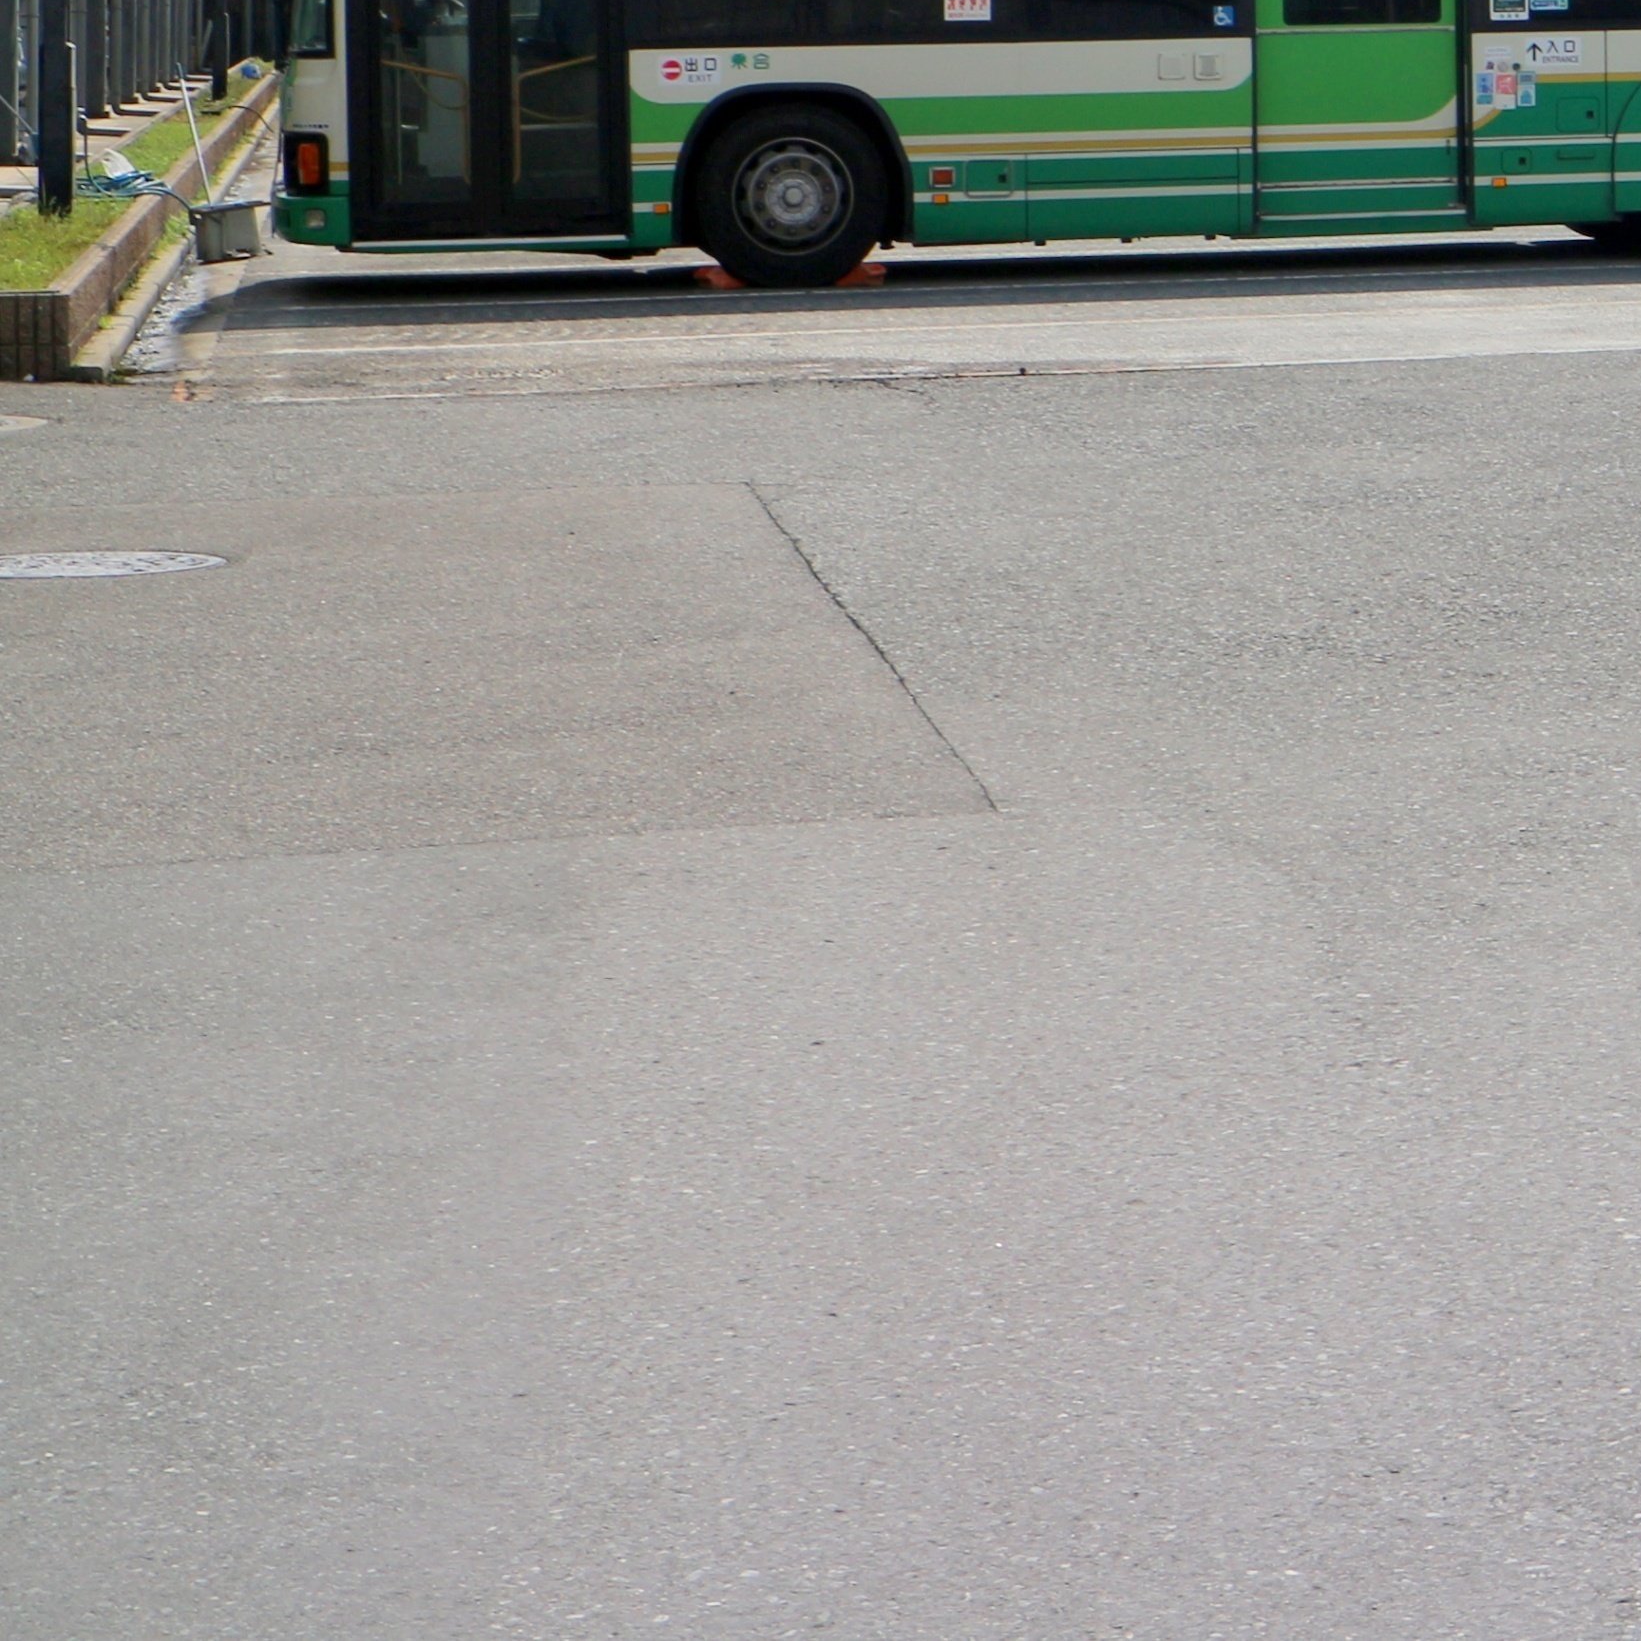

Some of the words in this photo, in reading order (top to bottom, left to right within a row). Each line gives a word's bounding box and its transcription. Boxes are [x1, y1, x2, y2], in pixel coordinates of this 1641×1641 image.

[1546, 40, 1575, 53] 入口
[684, 57, 717, 72] 出口
[1542, 55, 1579, 64] ENTRANCE
[688, 74, 713, 83] EXIT
